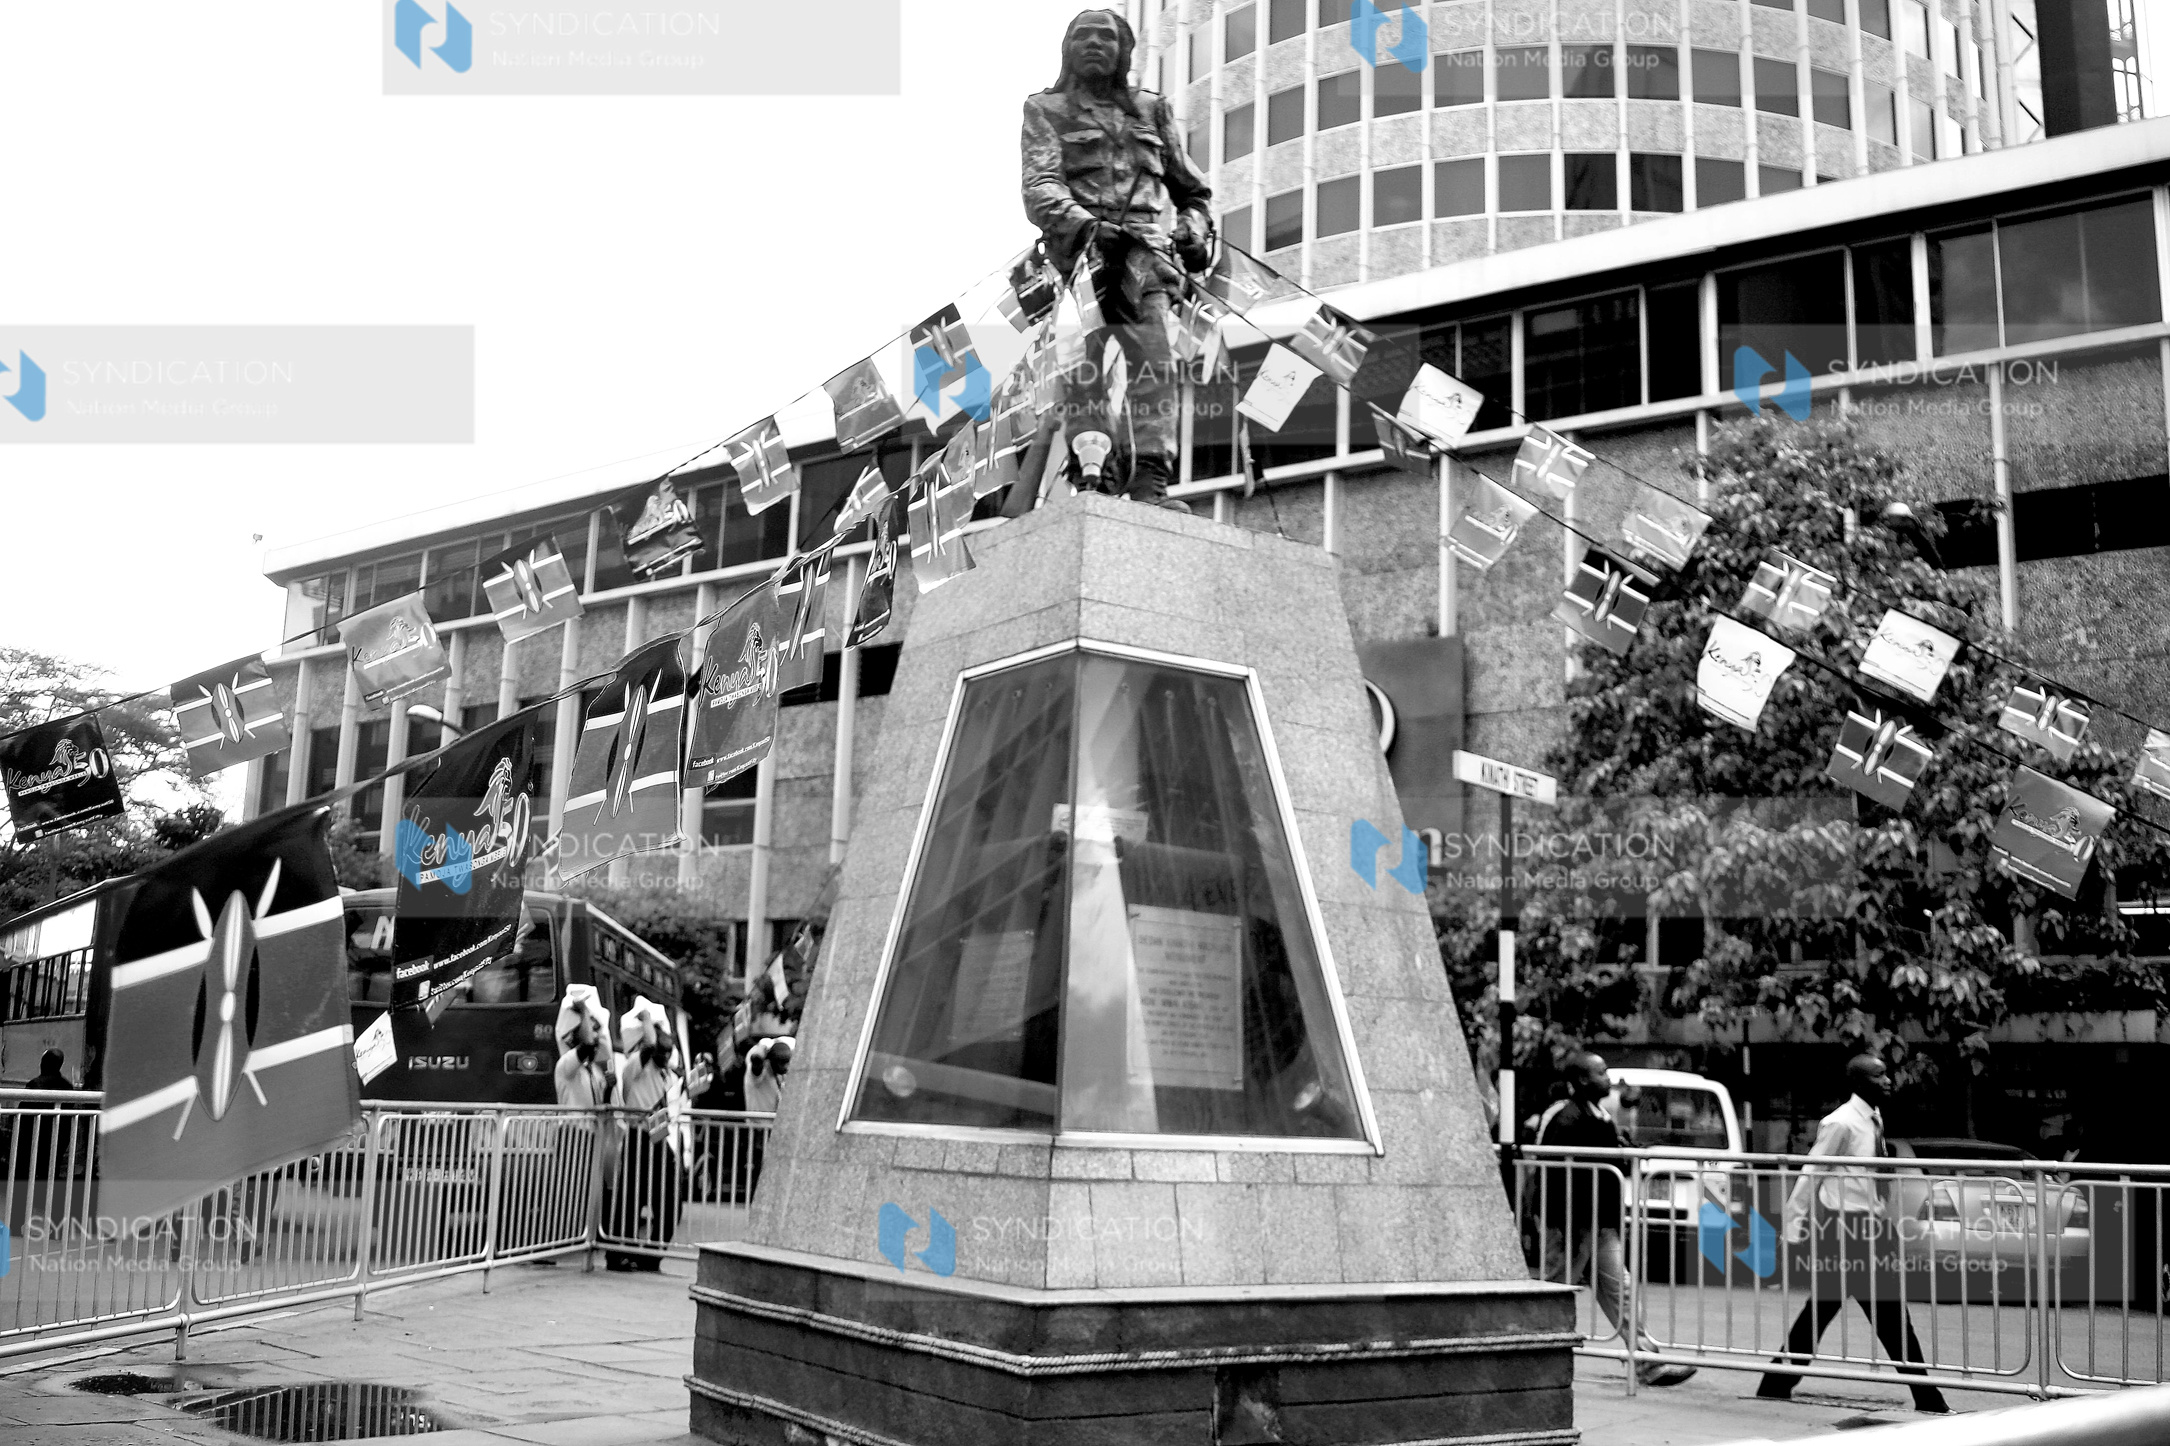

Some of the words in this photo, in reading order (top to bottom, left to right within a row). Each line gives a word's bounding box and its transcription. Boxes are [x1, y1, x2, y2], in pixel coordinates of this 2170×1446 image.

[6, 768, 67, 794] Kenya
[396, 960, 430, 979] facebook
[408, 1055, 470, 1071] ISUZU
